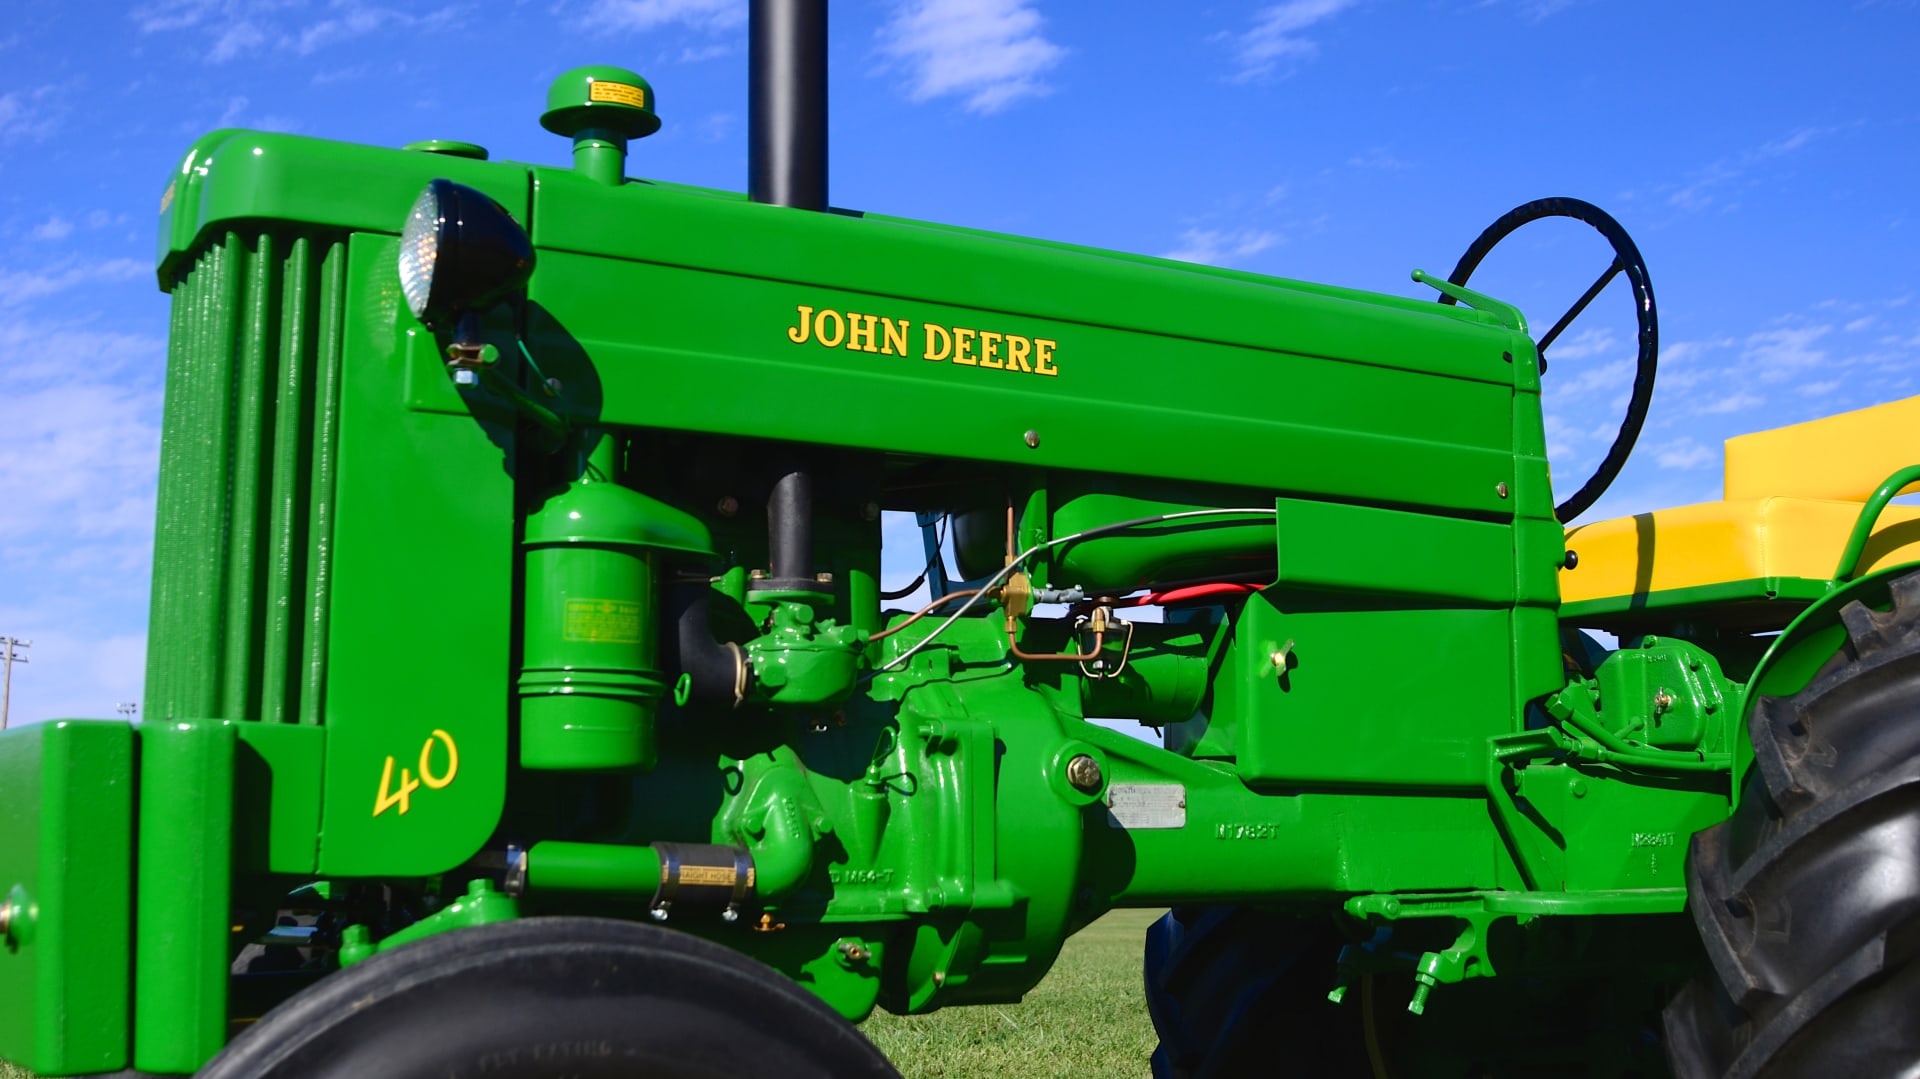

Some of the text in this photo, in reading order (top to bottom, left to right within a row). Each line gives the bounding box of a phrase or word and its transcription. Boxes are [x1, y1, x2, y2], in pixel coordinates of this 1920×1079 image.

[787, 305, 1058, 376] JOHN DEERE
[373, 728, 459, 817] 40
